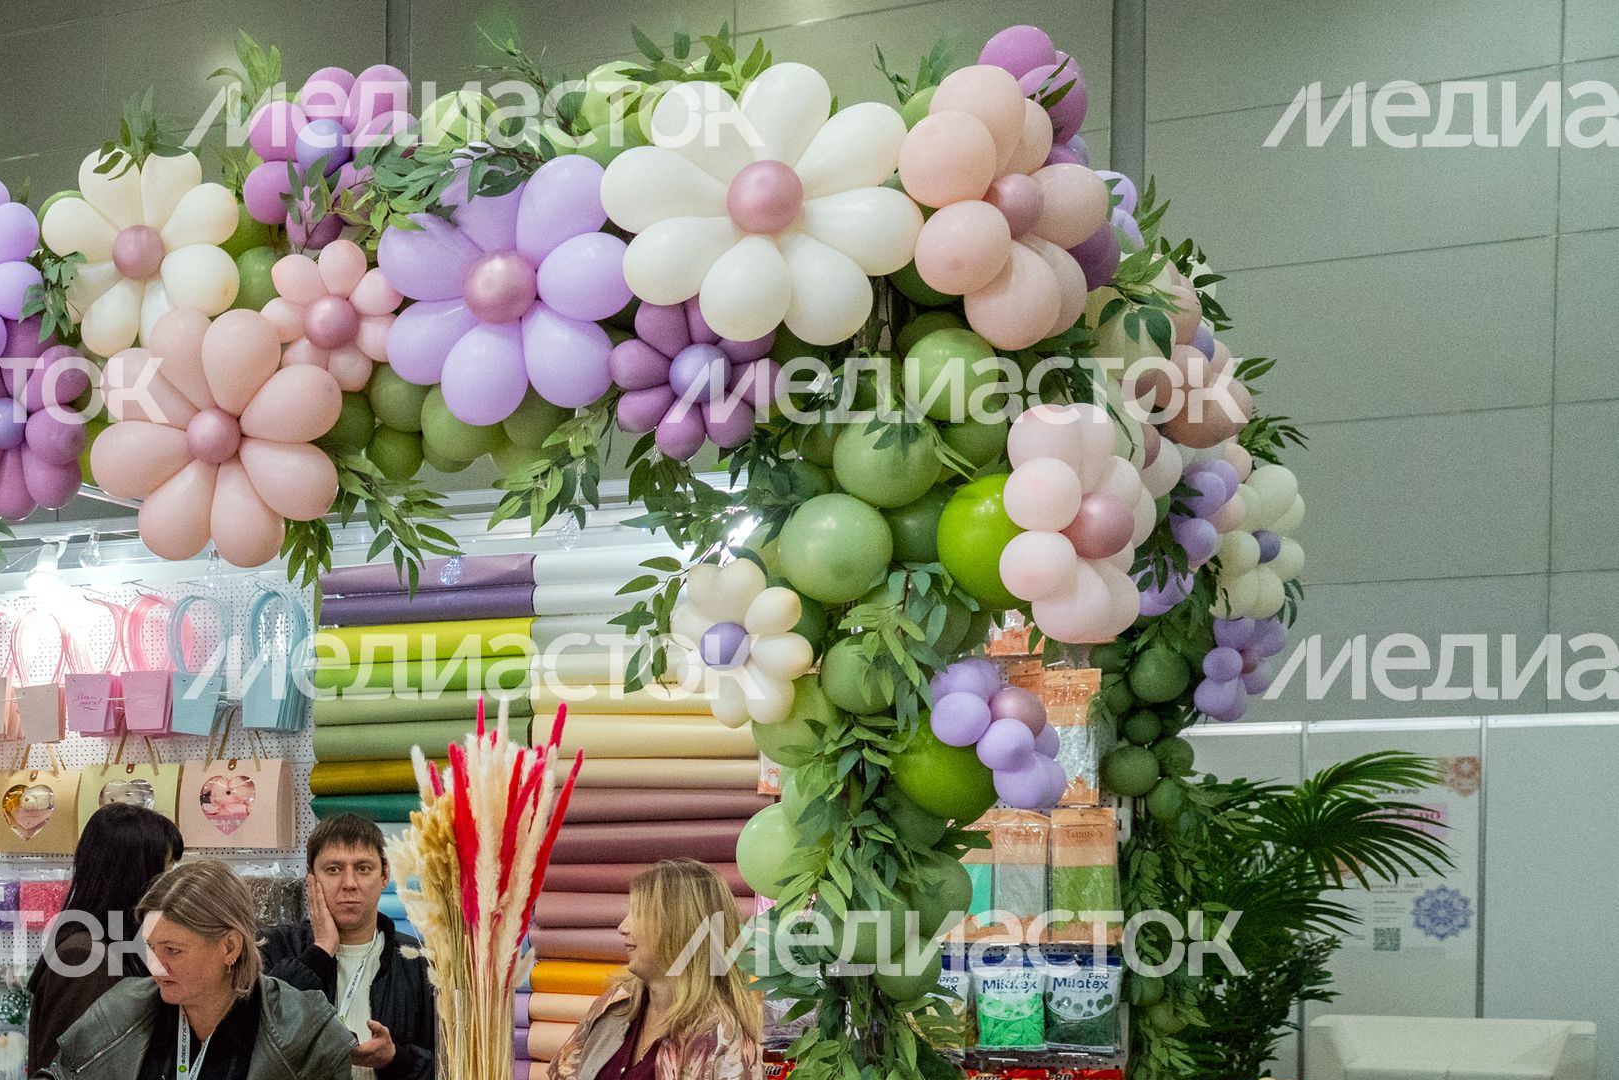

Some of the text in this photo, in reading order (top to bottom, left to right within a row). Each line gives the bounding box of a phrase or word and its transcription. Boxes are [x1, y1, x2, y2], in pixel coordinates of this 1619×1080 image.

[1088, 972, 1110, 980] PRO
[982, 978, 1037, 994] Milatex
[1052, 977, 1109, 993] Milatex
[764, 1065, 782, 1077] RO
